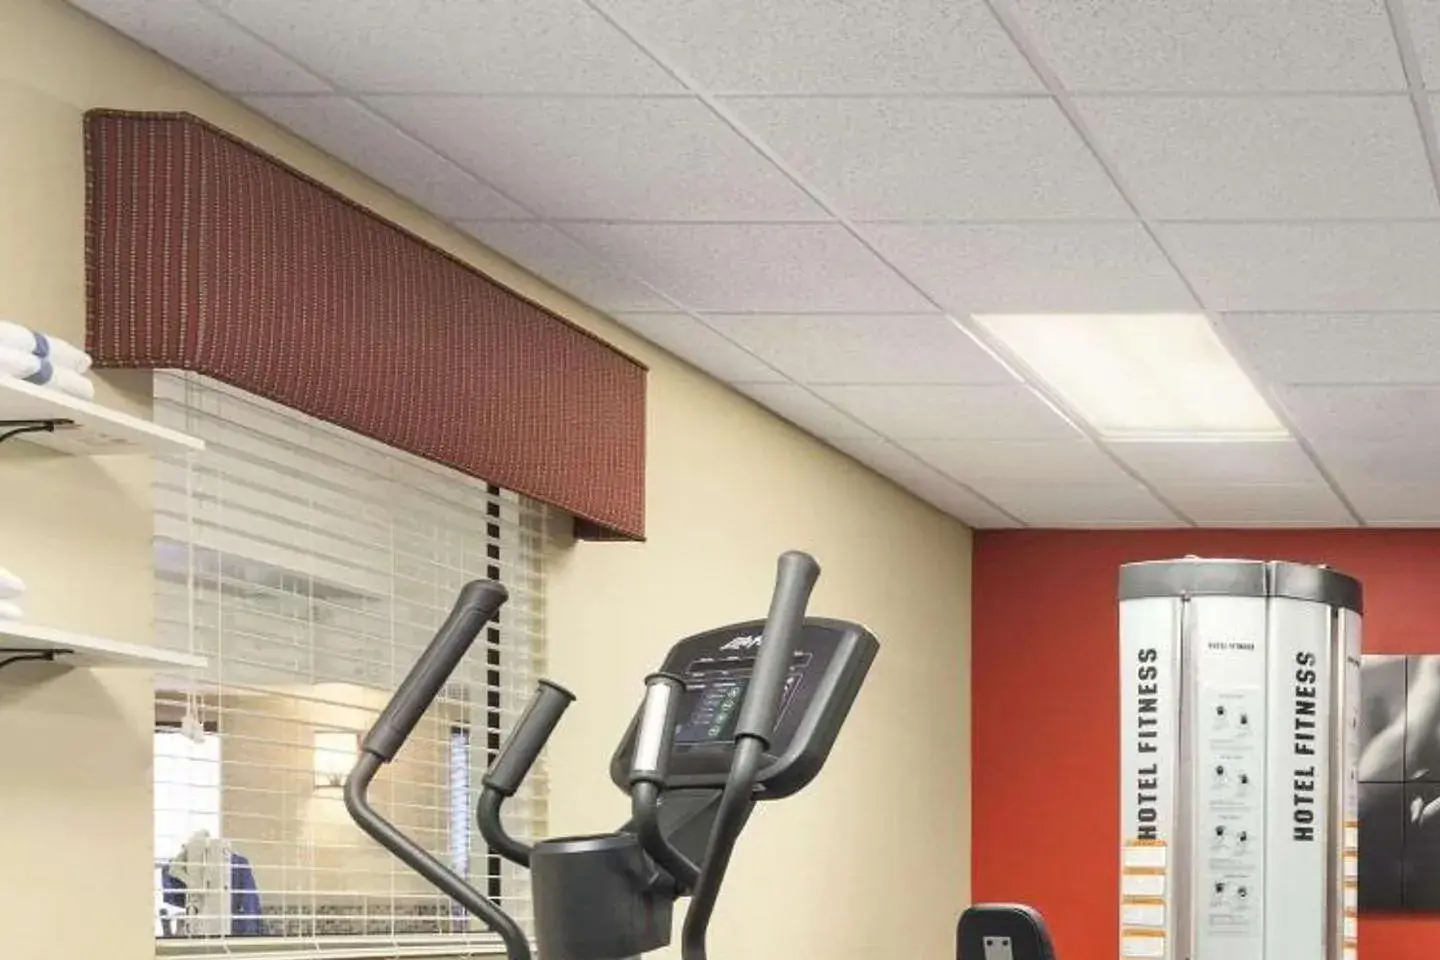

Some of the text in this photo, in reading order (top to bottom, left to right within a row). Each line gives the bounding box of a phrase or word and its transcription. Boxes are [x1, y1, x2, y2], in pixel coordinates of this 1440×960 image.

[1137, 648, 1158, 841] HOTEL FITNESS
[1292, 651, 1316, 842] HOTEL FITNESS
